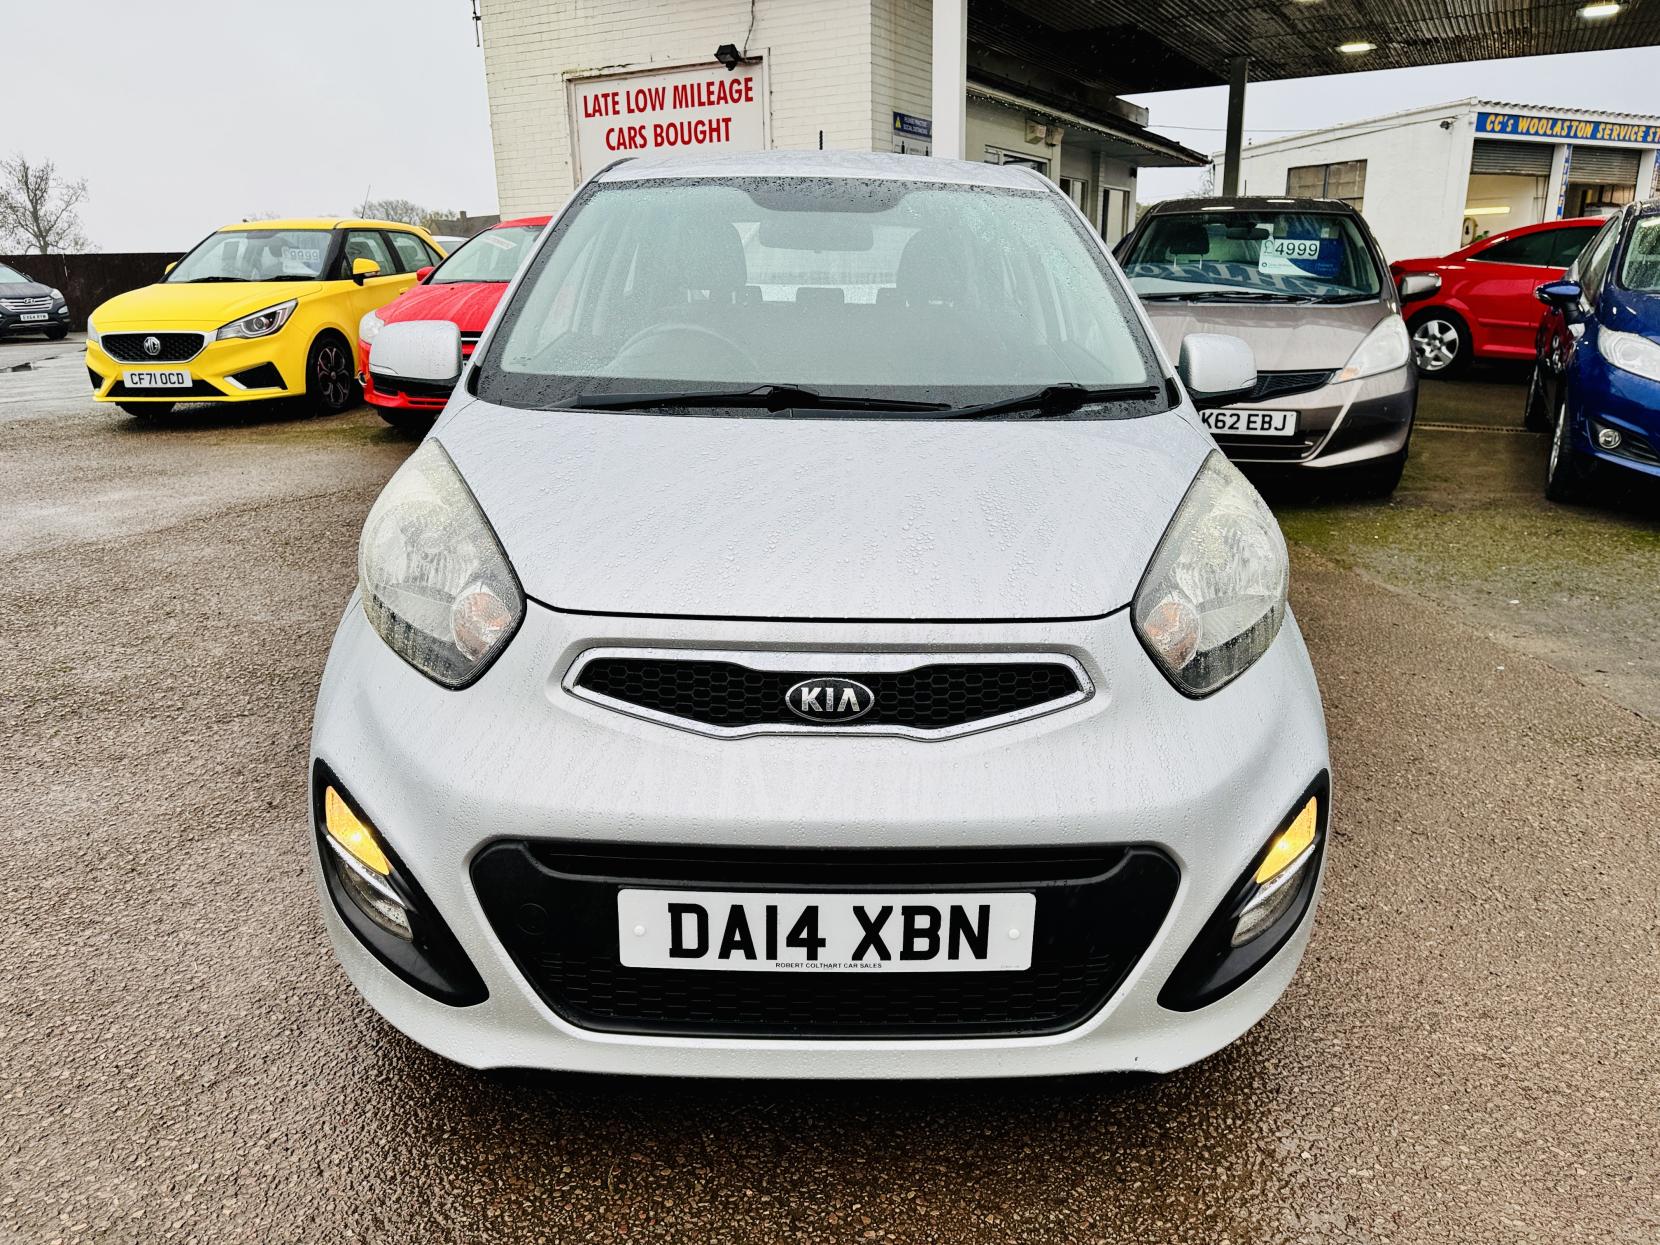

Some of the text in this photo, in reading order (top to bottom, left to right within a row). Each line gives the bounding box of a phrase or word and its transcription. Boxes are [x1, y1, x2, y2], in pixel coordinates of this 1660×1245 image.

[583, 76, 754, 118] LATE LOW MILEAGE
[605, 117, 732, 151] CARS BOUGHT
[1485, 114, 1514, 132] CC's
[1517, 116, 1594, 138] WOOLASTON
[1596, 123, 1645, 142] SERVICE
[130, 372, 185, 385] CF71 OCD
[1246, 413, 1287, 431] EBJ
[800, 687, 861, 712] KIA
[667, 902, 991, 961] DA14 XBN
